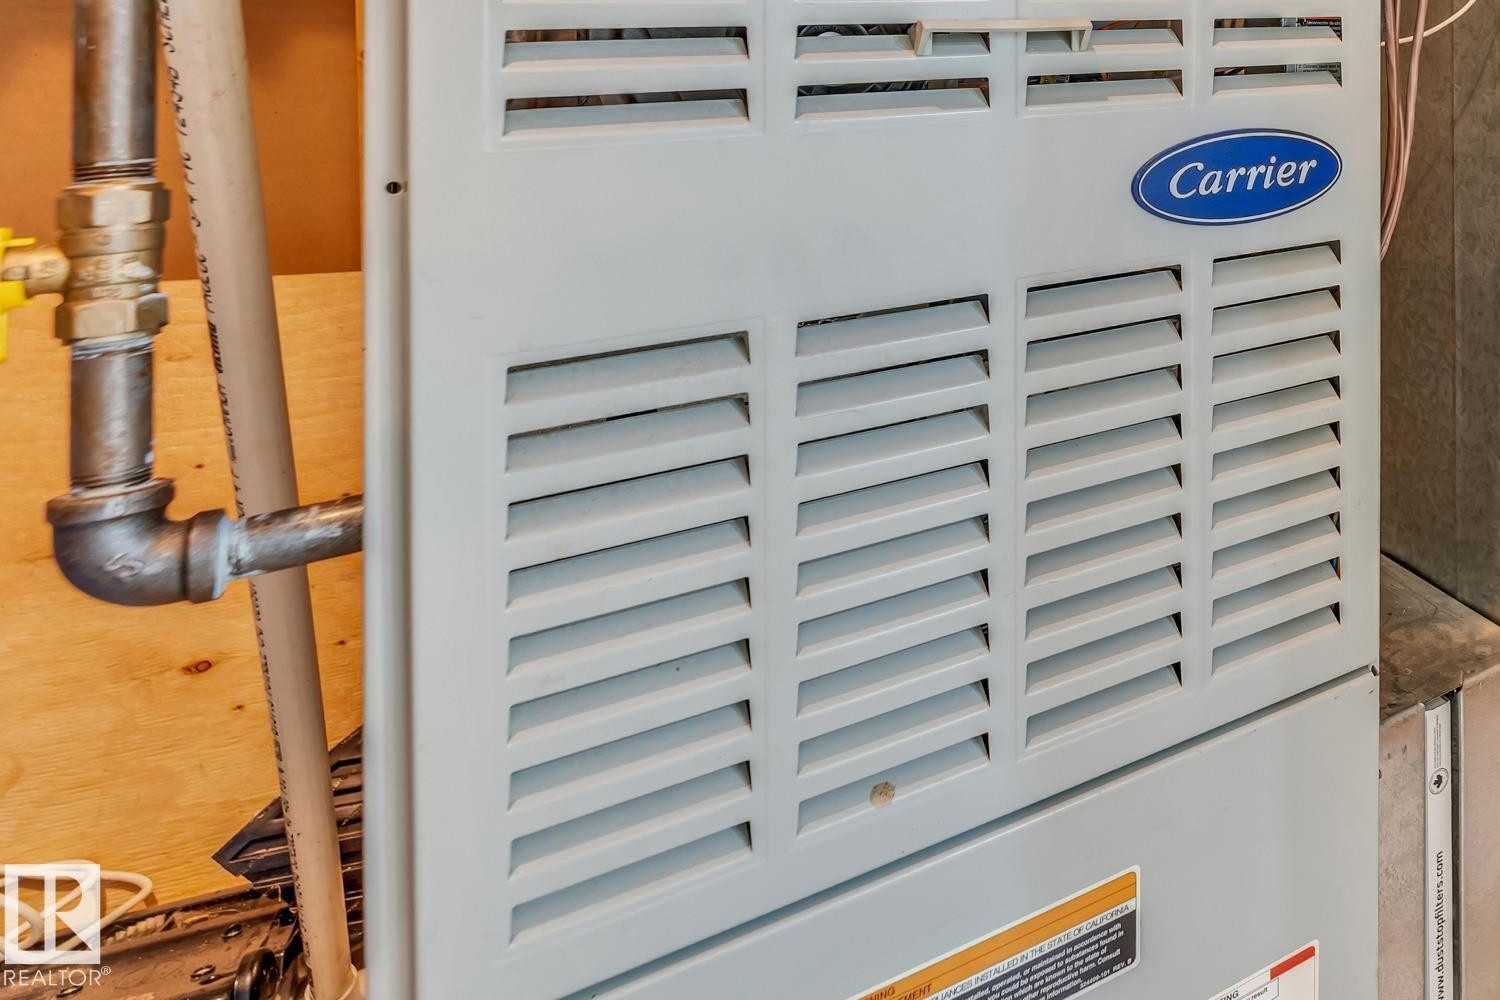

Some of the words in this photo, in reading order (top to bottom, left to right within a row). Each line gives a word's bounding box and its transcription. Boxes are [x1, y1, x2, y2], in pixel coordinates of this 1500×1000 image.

[1169, 155, 1318, 199] Carrier
[974, 956, 1018, 985] INSTALLED
[1020, 951, 1028, 963] IN
[1030, 943, 1045, 958] THE
[1047, 930, 1071, 950] STATE
[1073, 924, 1084, 937] OF
[1085, 902, 1129, 931] CALIFORNIA
[991, 969, 1021, 992] operated,
[1031, 948, 1065, 972] maintained
[1073, 928, 1107, 951] accordance
[1108, 921, 1121, 933] with
[1001, 980, 1019, 996] could
[1020, 975, 1028, 986] be
[1030, 962, 1056, 983] exposed
[1065, 941, 1098, 964] substances
[1099, 932, 1116, 947] found
[1039, 968, 1078, 996] reproductive
[1097, 947, 1120, 966] Consult
[1013, 983, 1032, 999] which
[1045, 966, 1065, 983] known
[1074, 957, 1084, 968] the
[1085, 949, 1099, 963] state
